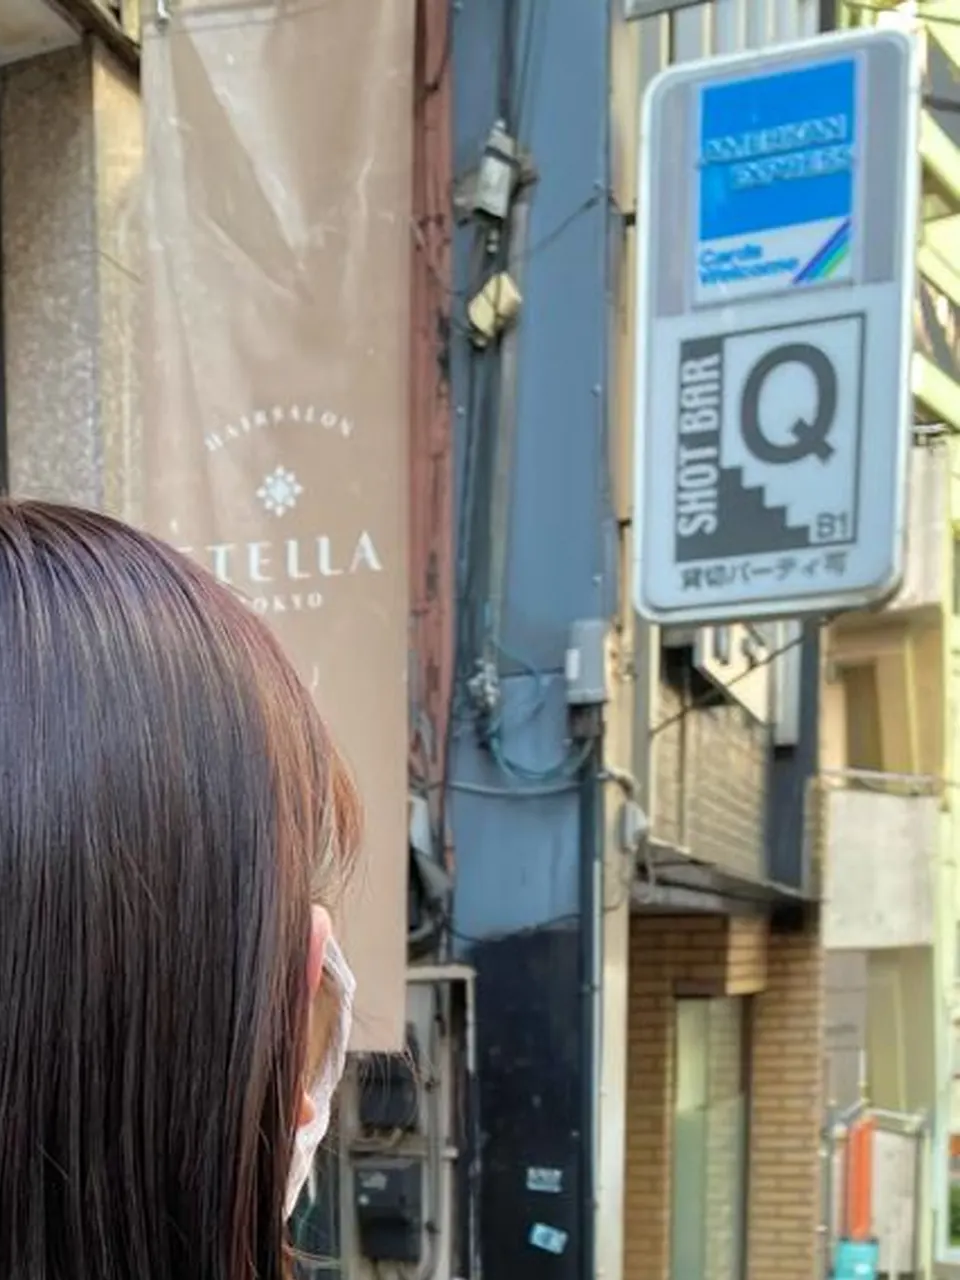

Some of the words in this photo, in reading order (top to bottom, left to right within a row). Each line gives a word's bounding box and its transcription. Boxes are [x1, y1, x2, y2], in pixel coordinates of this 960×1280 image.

[682, 353, 721, 432] BAR
[740, 343, 838, 465] Q
[677, 445, 718, 537] SHOT
[816, 511, 849, 539] B1
[180, 530, 383, 583] TELLA
[681, 553, 847, 590] 貸切パーティ可
[238, 592, 324, 614] OKYO
